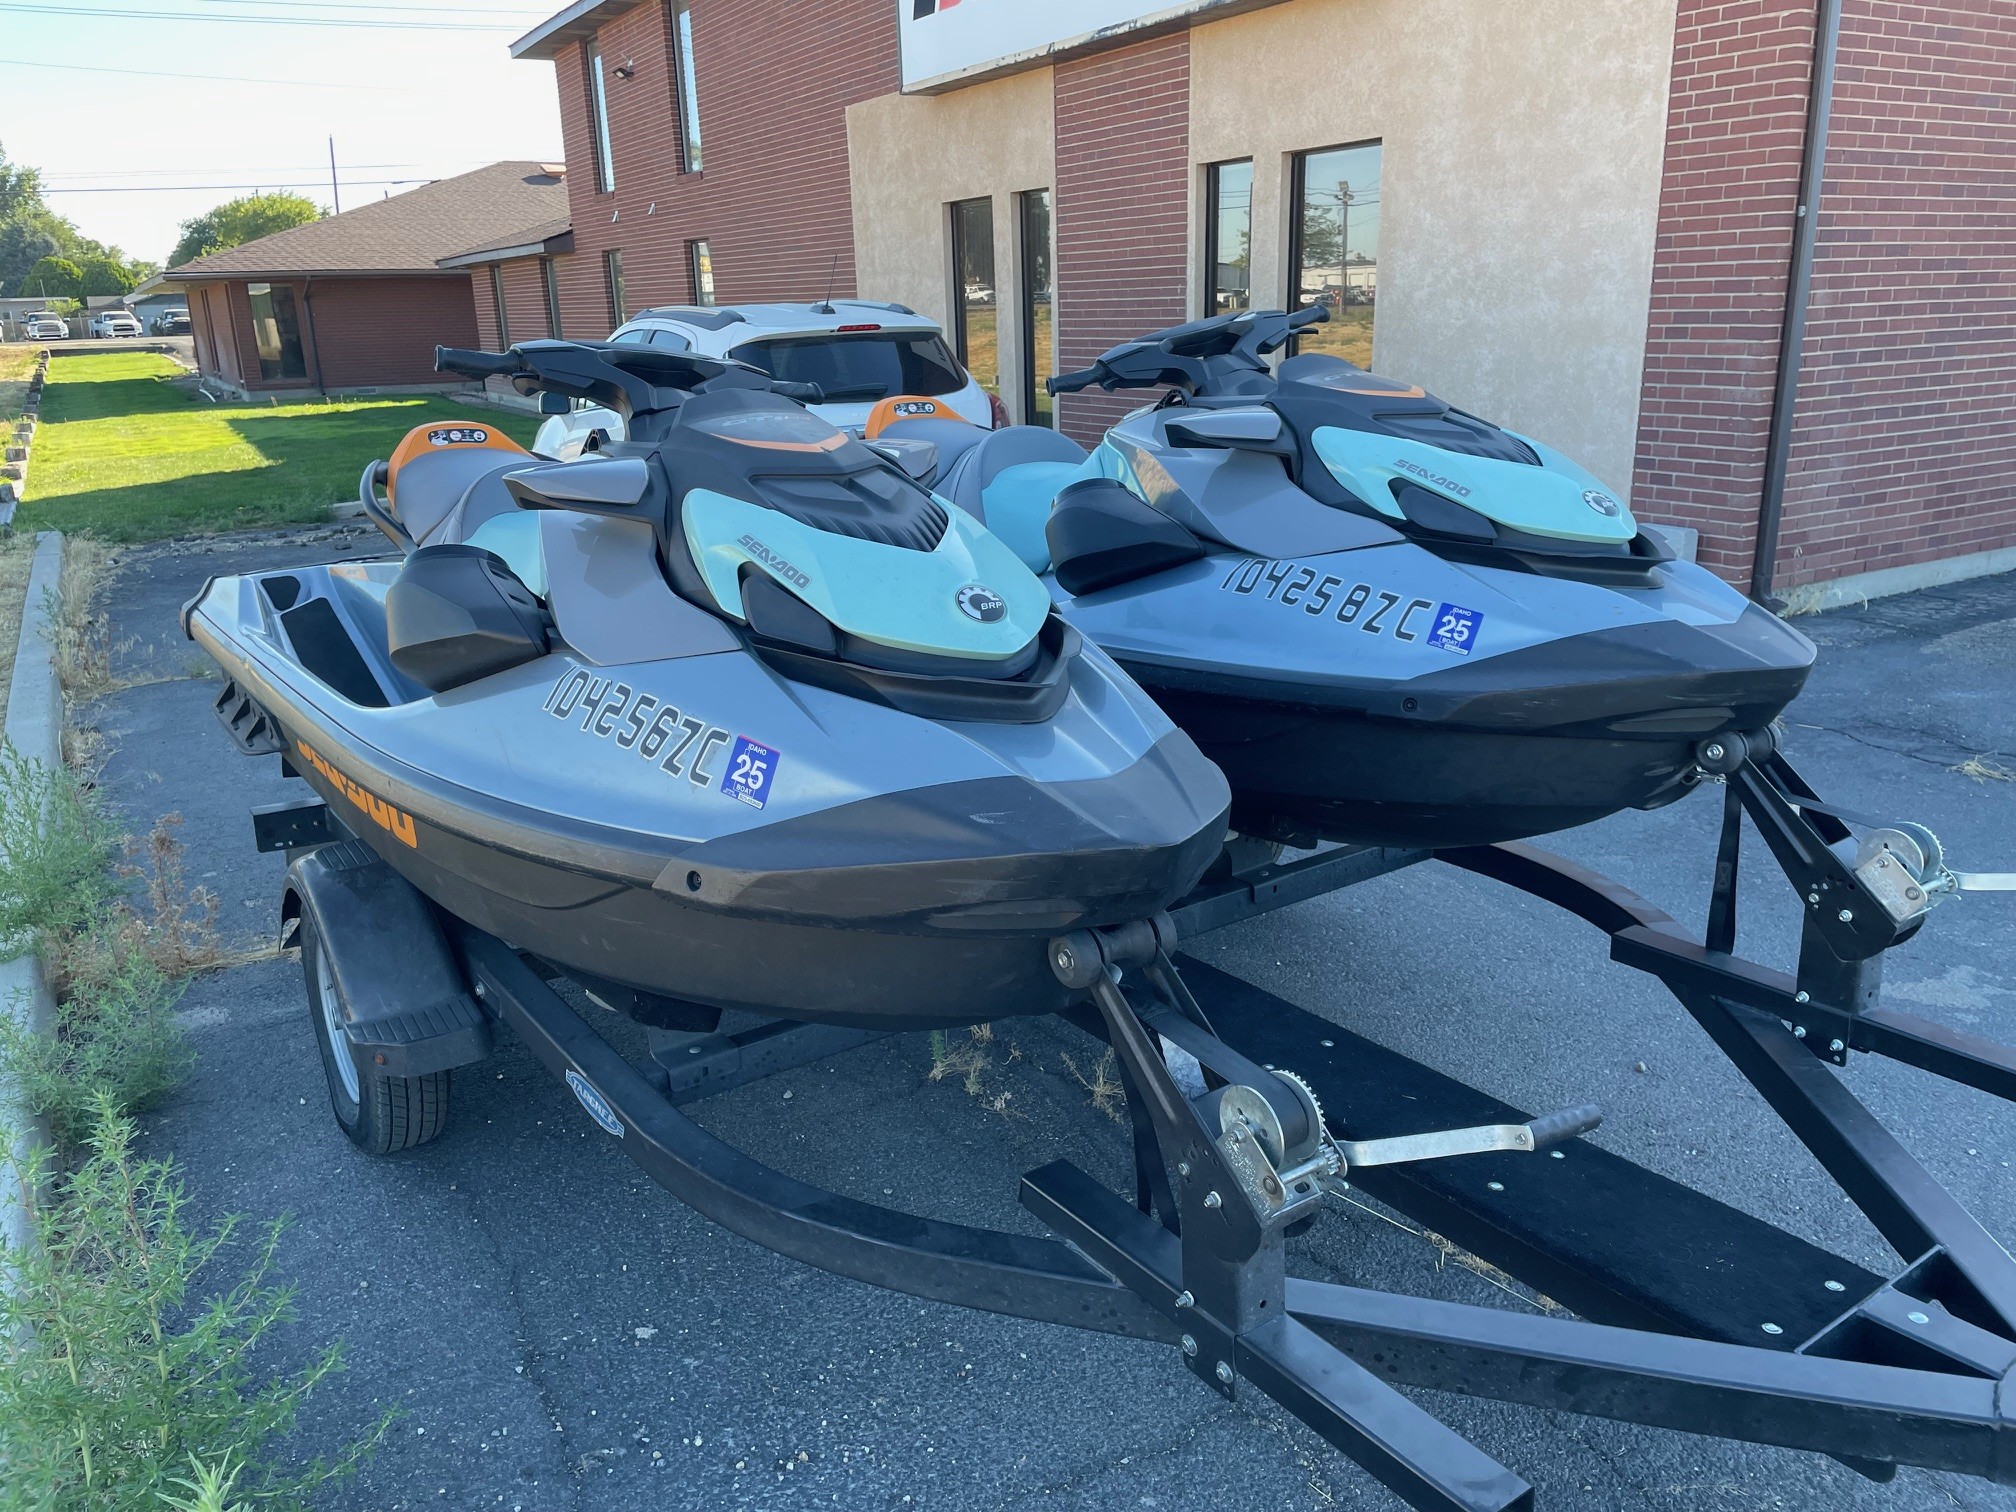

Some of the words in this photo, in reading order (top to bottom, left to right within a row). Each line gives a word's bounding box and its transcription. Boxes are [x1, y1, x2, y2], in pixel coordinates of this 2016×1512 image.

[980, 601, 1003, 611] BRP
[1452, 606, 1473, 617] IDAHO
[1436, 615, 1473, 642] 25
[1441, 637, 1459, 646] BOAT
[748, 742, 768, 757] IDAHO
[730, 753, 768, 790] 25
[736, 783, 753, 796] BOAT
[571, 1077, 616, 1131] TARGHEE
